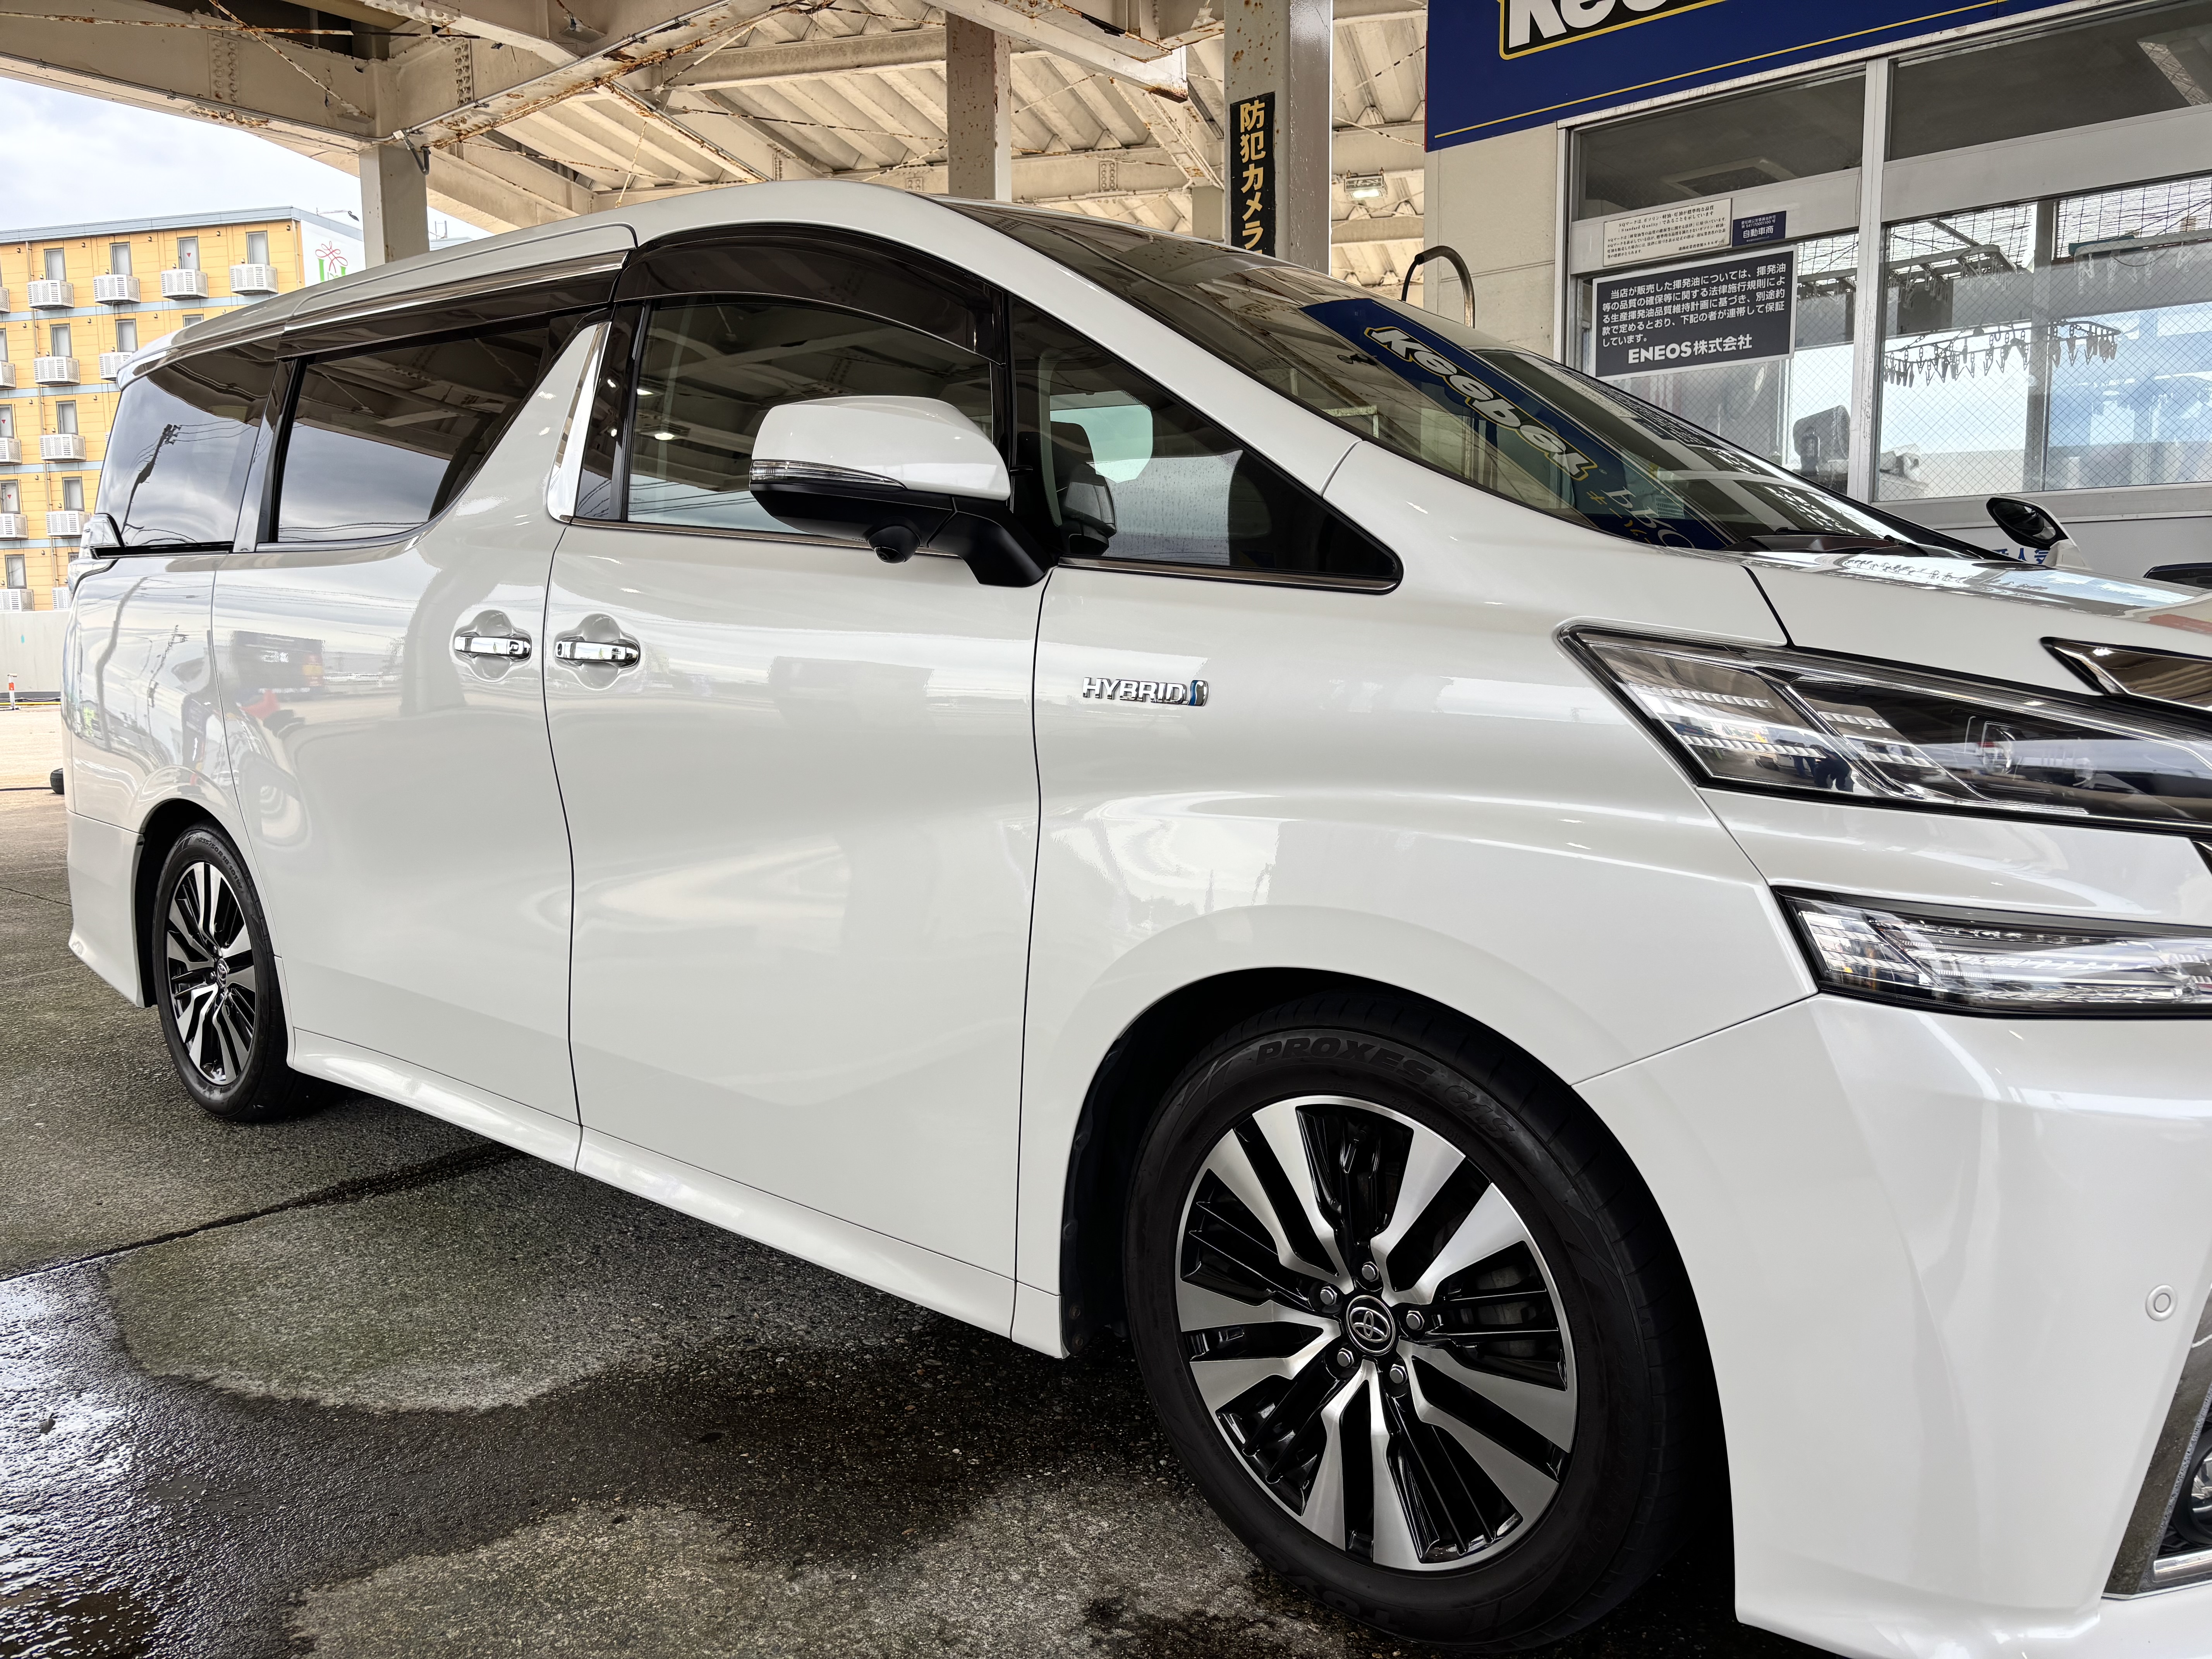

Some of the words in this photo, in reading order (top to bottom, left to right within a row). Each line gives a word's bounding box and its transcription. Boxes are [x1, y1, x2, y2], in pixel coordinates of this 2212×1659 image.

[1240, 100, 1266, 254] 防犯カメラ
[1743, 225, 1774, 238] 自動車商
[1602, 280, 1786, 311] 等の品質の確保等に関する法律施行規則によ
[1610, 263, 1786, 299] 当店が販売した揮発油については、揮発油
[1602, 288, 1785, 324] る生産揮発油品質維持計画に基づき、別途約
[1602, 301, 1785, 336] 款で定めるとおり、下記の者が連帯して保証
[1602, 334, 1647, 347] しています。
[1628, 334, 1752, 364] ENEOS株式会社
[1082, 677, 1187, 704] HYBRID
[1255, 1037, 1436, 1085] PROXES
[1444, 1085, 1517, 1140] C1S
